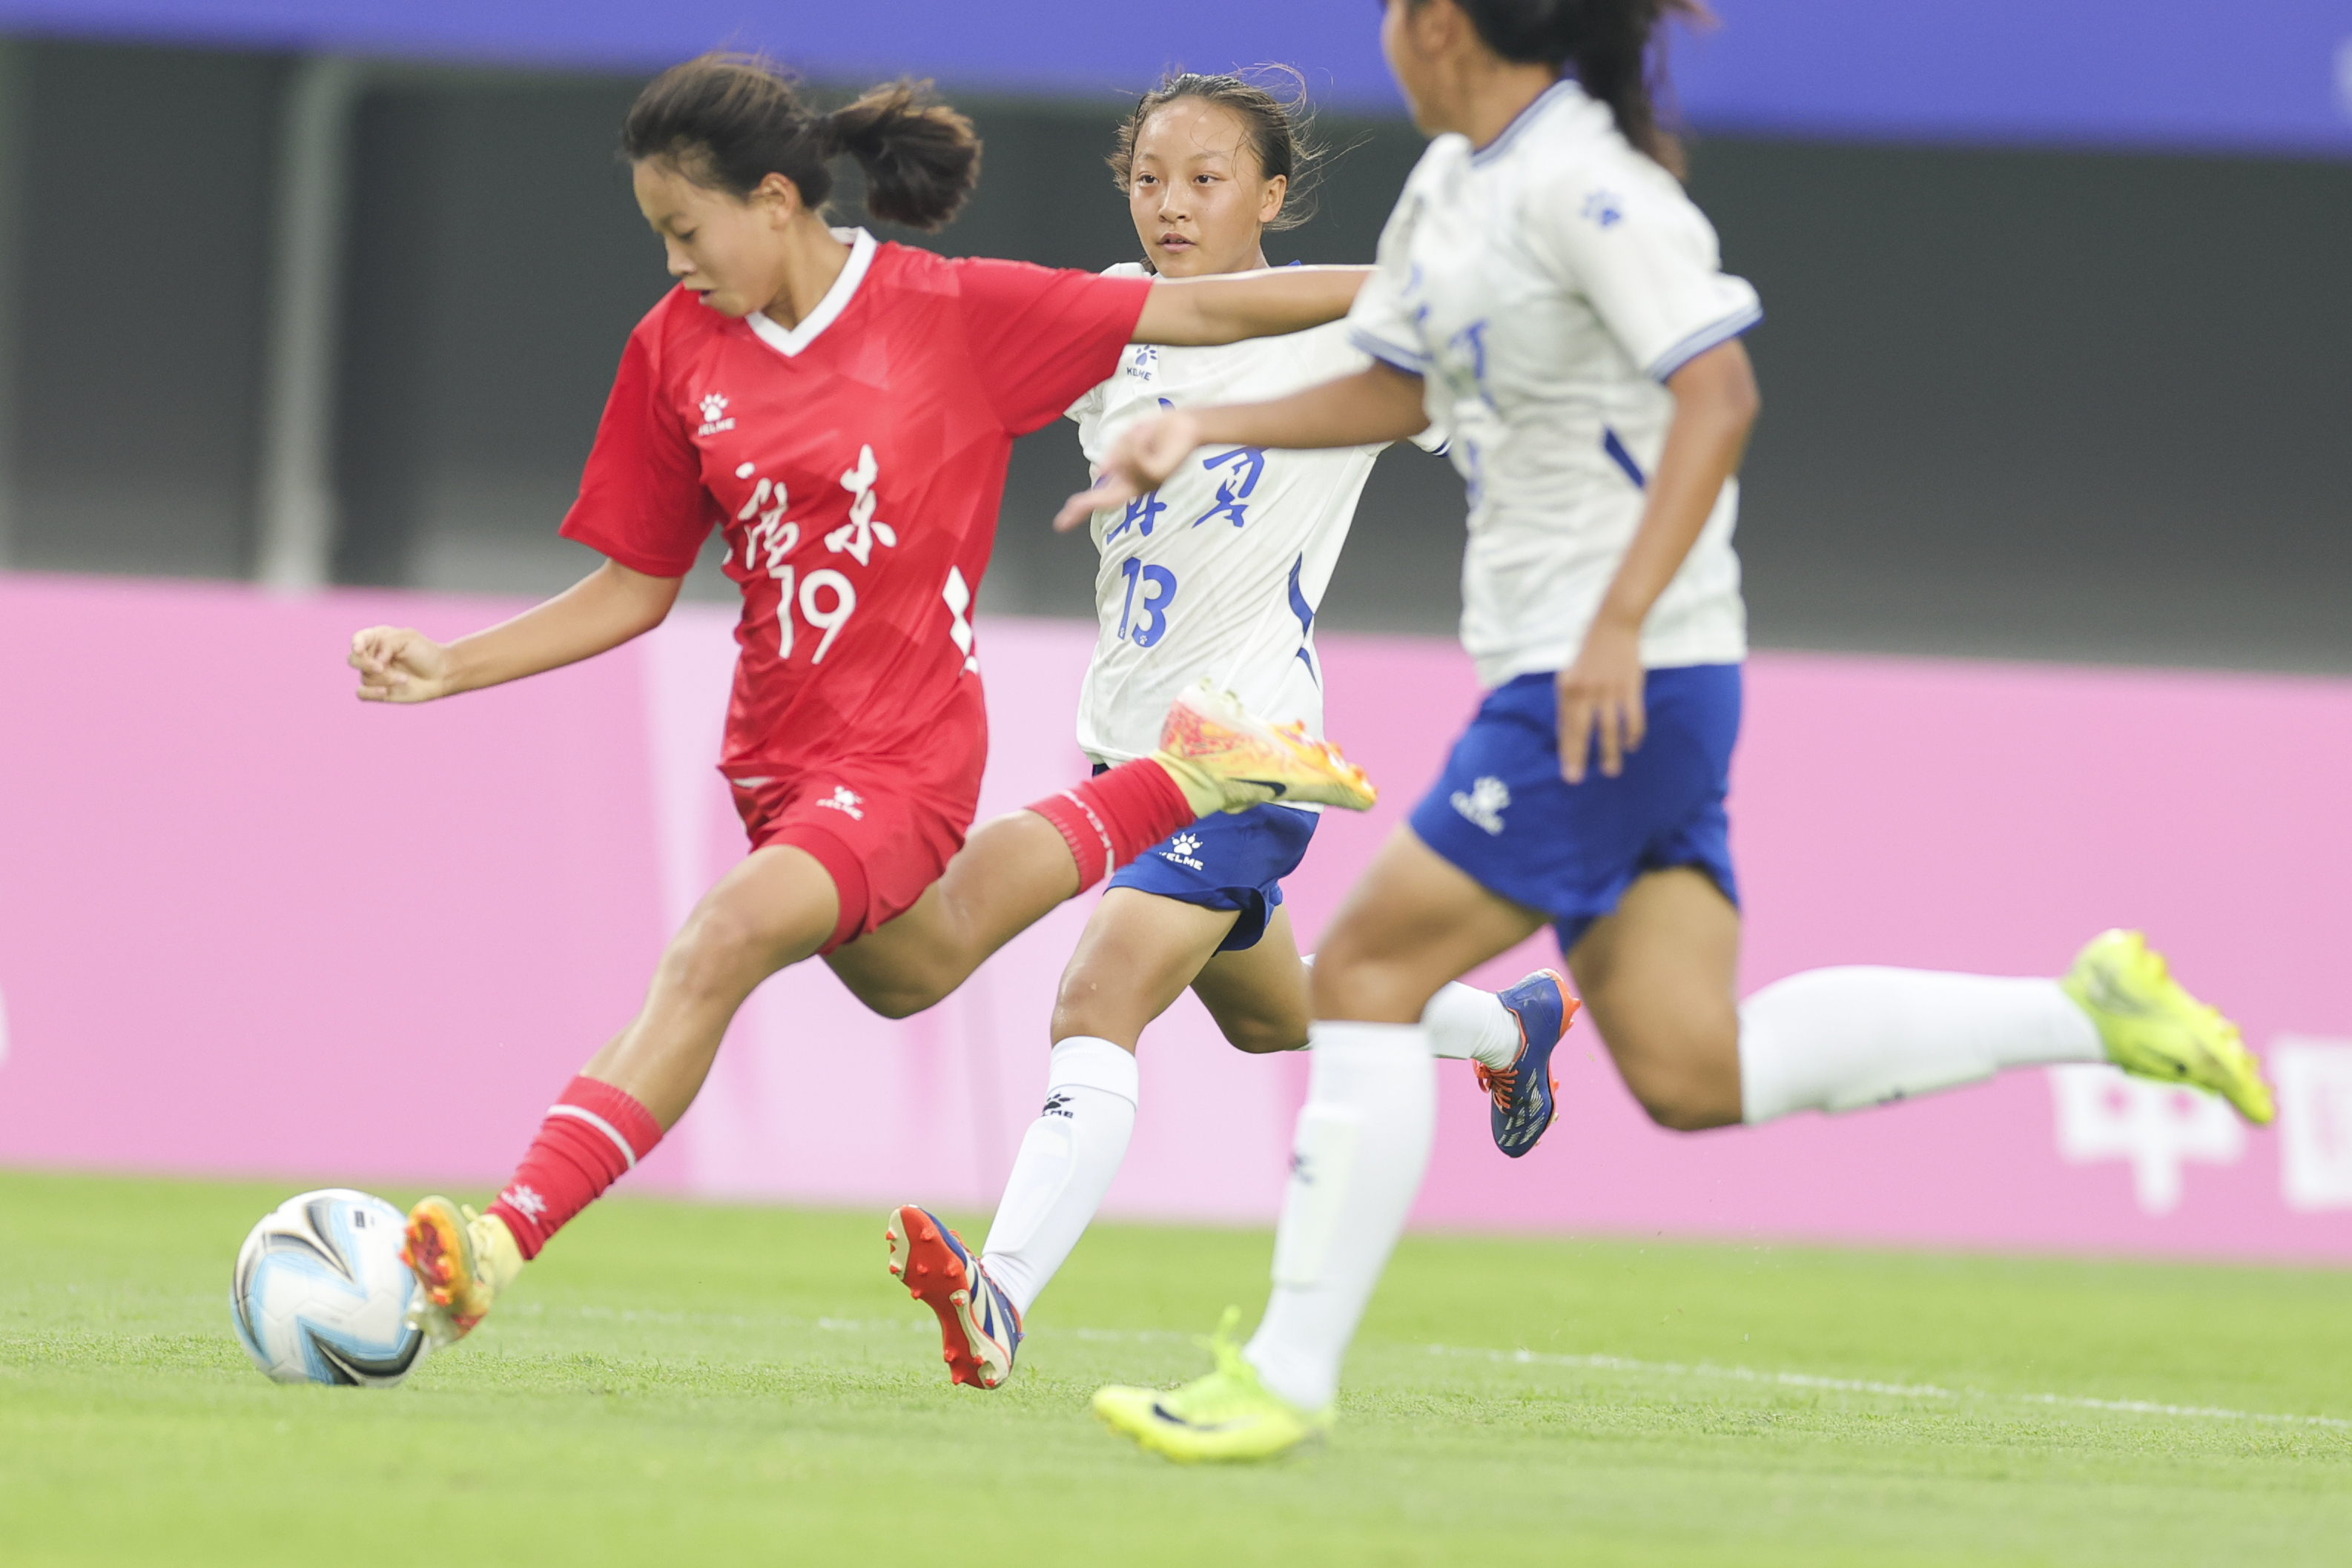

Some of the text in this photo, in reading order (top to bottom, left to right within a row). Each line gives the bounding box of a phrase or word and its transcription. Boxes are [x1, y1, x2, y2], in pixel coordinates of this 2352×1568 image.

[768, 564, 857, 665] 19
[1117, 556, 1177, 648] 13
[1158, 851, 1204, 871] ELME
